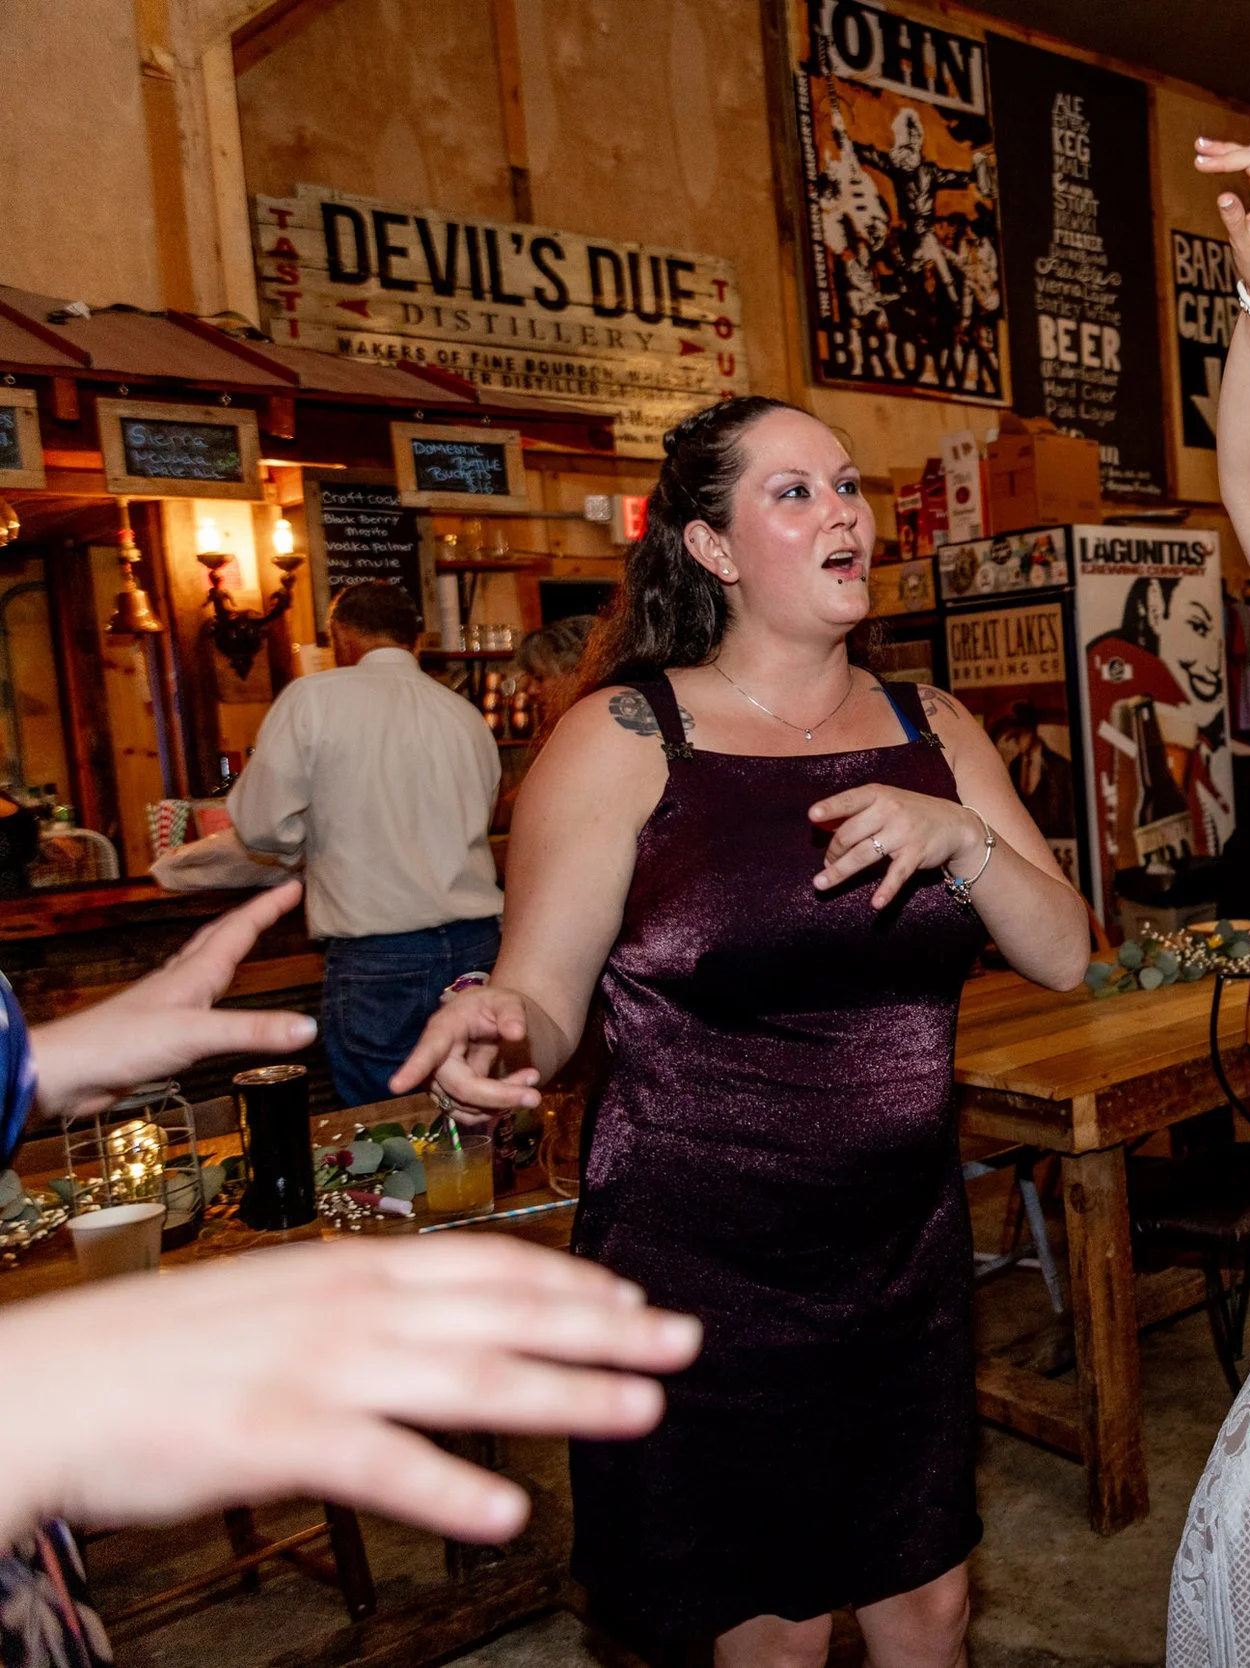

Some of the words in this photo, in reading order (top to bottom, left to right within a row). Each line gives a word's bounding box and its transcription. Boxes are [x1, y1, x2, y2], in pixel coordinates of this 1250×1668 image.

[1052, 128, 1090, 163] KEG
[808, 203, 824, 241] BARN
[320, 202, 569, 311] DEVIL'S
[587, 246, 702, 330] DUE
[812, 244, 828, 288] EVENT
[817, 289, 831, 318] THE
[402, 302, 654, 350] DISTILLERY
[1038, 313, 1121, 371] BEER
[337, 336, 426, 362] MAKERS
[437, 349, 461, 366] OF
[470, 351, 516, 373] FINE
[824, 325, 1001, 395] BROWN
[1080, 536, 1206, 566] LAGUNITAS
[951, 619, 999, 662] GREAT
[1005, 613, 1059, 657] LAKES
[953, 662, 1029, 681] BREWING
